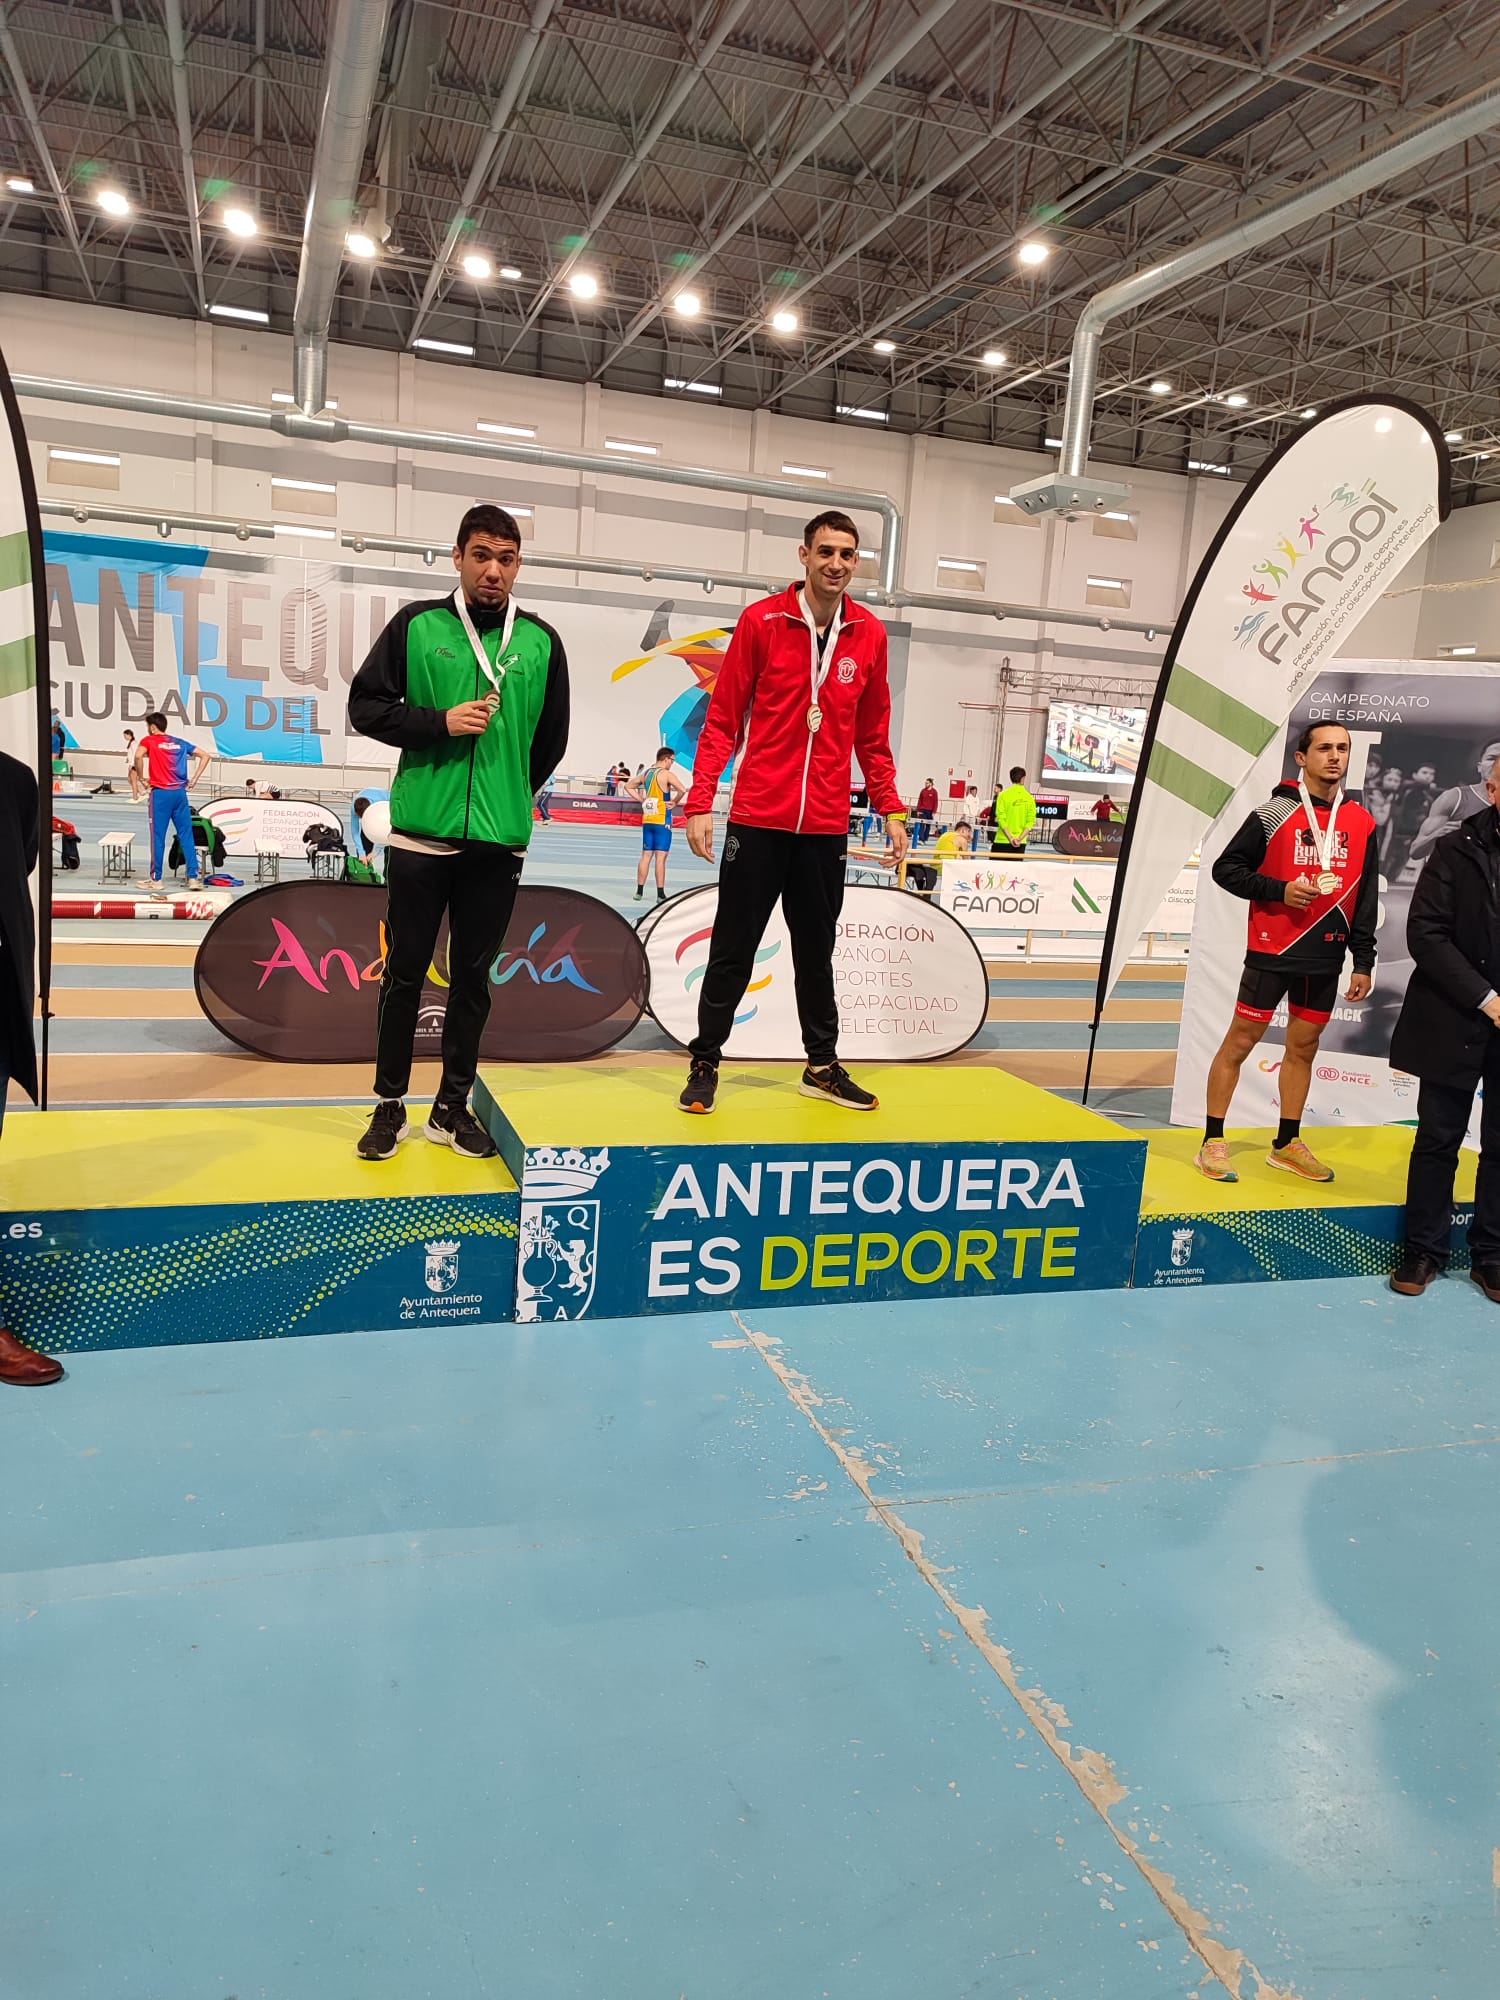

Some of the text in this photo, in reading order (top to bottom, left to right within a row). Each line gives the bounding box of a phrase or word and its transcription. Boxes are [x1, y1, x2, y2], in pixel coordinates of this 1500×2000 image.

[1286, 503, 1435, 693] para Personas con Discapacidad Intelectual
[1293, 519, 1409, 666] Federación Andaluza de Deportes
[46, 562, 418, 692] ANTEQU
[1310, 692, 1430, 708] CAMPEONATO
[245, 695, 331, 735] DEL
[1309, 708, 1403, 723] DE ESPAÑA
[835, 922, 935, 943] DERACIÓN
[835, 970, 913, 988] PORTES
[836, 994, 958, 1012] CAPACIDAD
[841, 1018, 944, 1035] ELECTUAL
[1341, 1076, 1370, 1085] ONCE
[652, 1158, 1086, 1220] ANTEQUERA
[648, 1226, 1081, 1298] ES DEPORTE
[1153, 1267, 1205, 1277] Ayuntamiento
[1153, 1276, 1203, 1285] de Antequera
[399, 1293, 483, 1310] Ayuntamiento
[400, 1306, 481, 1319] de Antequera
